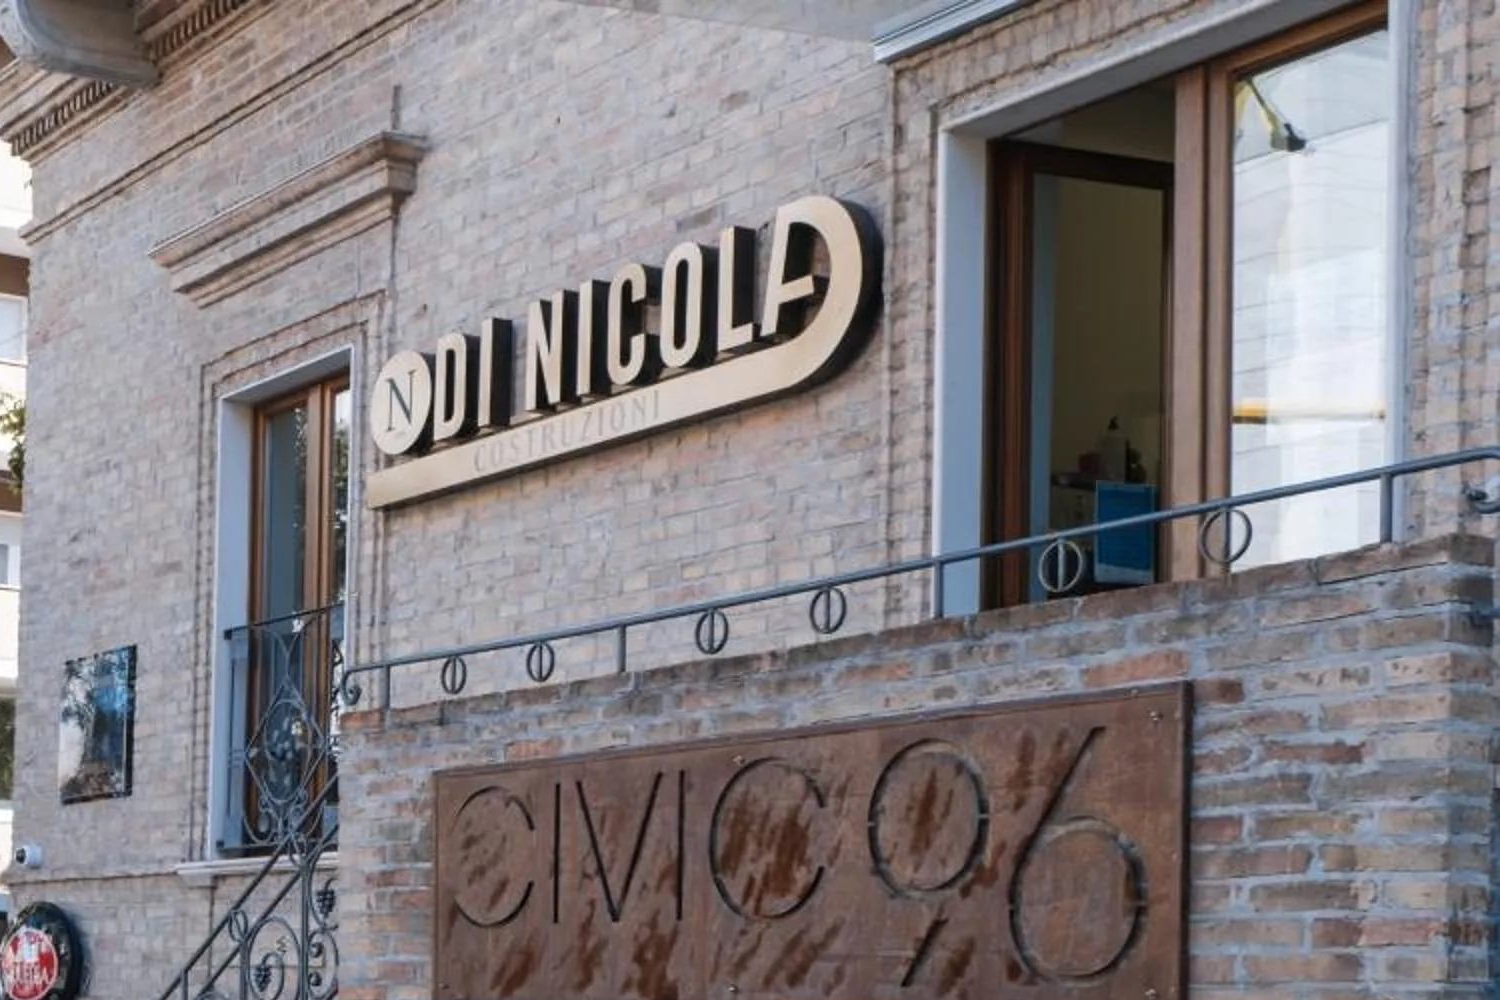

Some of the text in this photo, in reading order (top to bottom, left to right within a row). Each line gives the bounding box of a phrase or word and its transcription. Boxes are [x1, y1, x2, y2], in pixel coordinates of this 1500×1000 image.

[433, 317, 500, 441] DI
[525, 195, 864, 412] NICOLA
[473, 388, 661, 473] COSTRUZIONI
